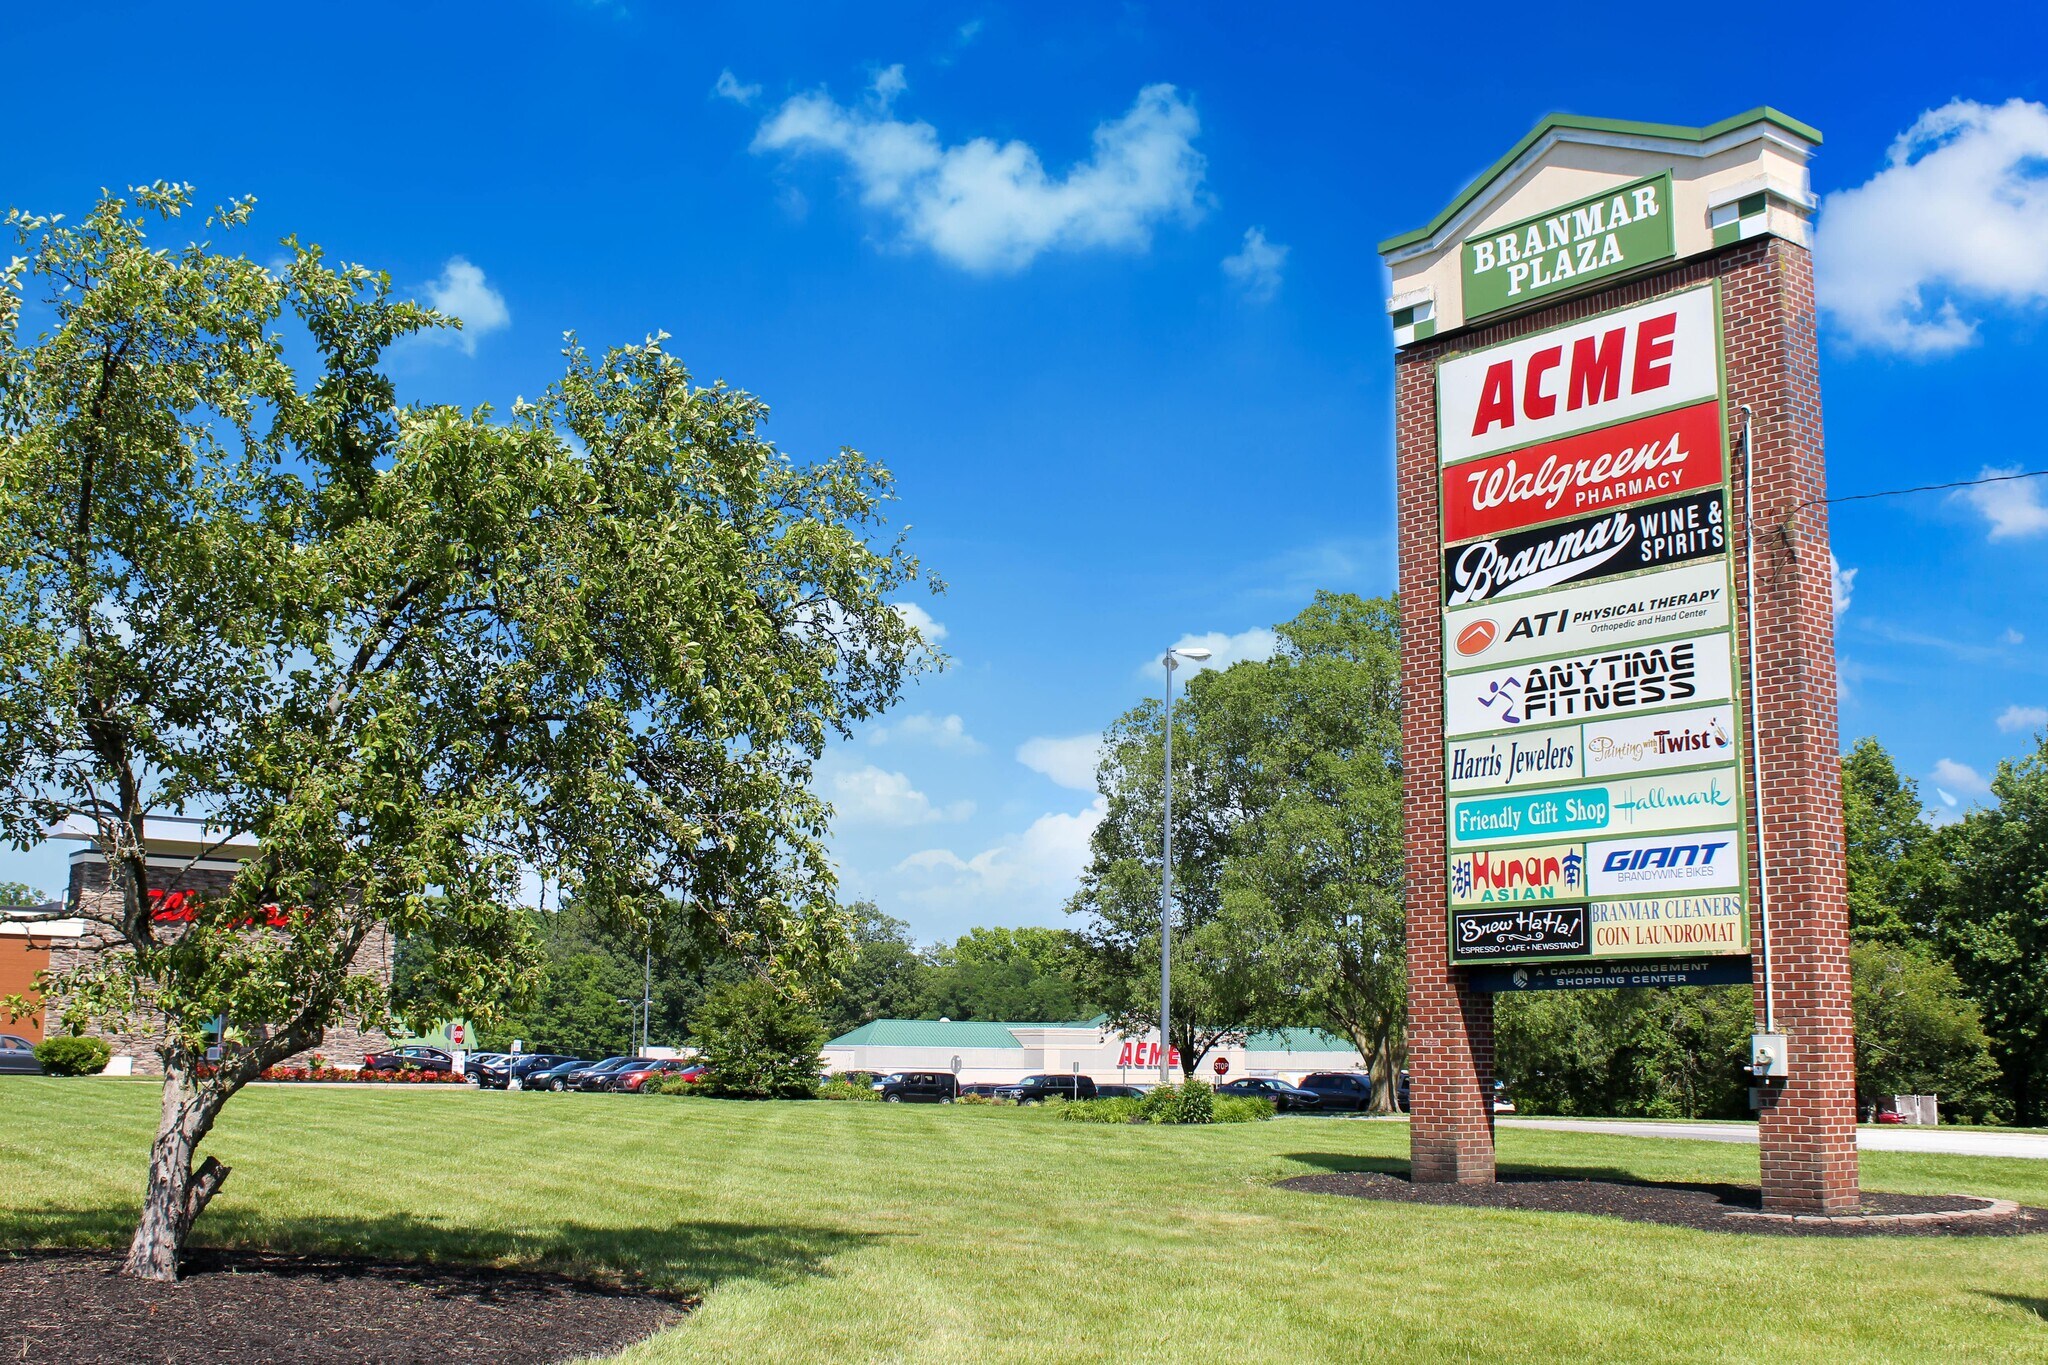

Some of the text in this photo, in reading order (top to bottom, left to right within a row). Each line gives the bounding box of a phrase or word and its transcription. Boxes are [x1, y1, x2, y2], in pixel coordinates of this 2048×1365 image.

[1473, 185, 1659, 274] BRANMAR
[1506, 233, 1624, 297] PLAZA
[1471, 312, 1677, 437] ACME
[1467, 432, 1689, 511] Walgreens
[1575, 468, 1683, 507] PHARMACY
[1448, 500, 1722, 606] Branmar WINE &
[1641, 526, 1723, 562] SPIRITS
[1504, 588, 1720, 643] ATI PHYSICAL THERAPY
[1590, 608, 1707, 634] Orthopedic and Hand Center
[1525, 643, 1694, 694] ANYTIME
[1525, 671, 1695, 720] FITNESS
[1451, 738, 1573, 784] Harris Jewelers
[1588, 736, 1643, 762] Painting
[1643, 739, 1657, 748] with
[1654, 729, 1710, 754] Twist
[1459, 797, 1606, 832] Friendly Gift Shop
[1612, 777, 1732, 824] Hallmark
[1472, 851, 1560, 890] Hunan
[1561, 847, 1582, 892] 南
[1602, 842, 1730, 872] GIANT
[1617, 866, 1714, 882] BRANDYWINE BIKES
[1481, 886, 1554, 902] ASIAN
[1592, 896, 1741, 923] BRANMAR CLEANERS
[1460, 919, 1513, 942] Brew
[1460, 942, 1579, 954] ESPRESSO CAFE NEWSSTAND
[1597, 922, 1735, 946] COIN LAUNDROMAT
[1550, 966, 1603, 976] CAPANO
[1610, 963, 1709, 974] MANAGEMENT
[1556, 974, 1687, 986] SHOPPING CENTER
[1118, 1042, 1179, 1065] ACME
[1214, 1062, 1229, 1070] STOP
